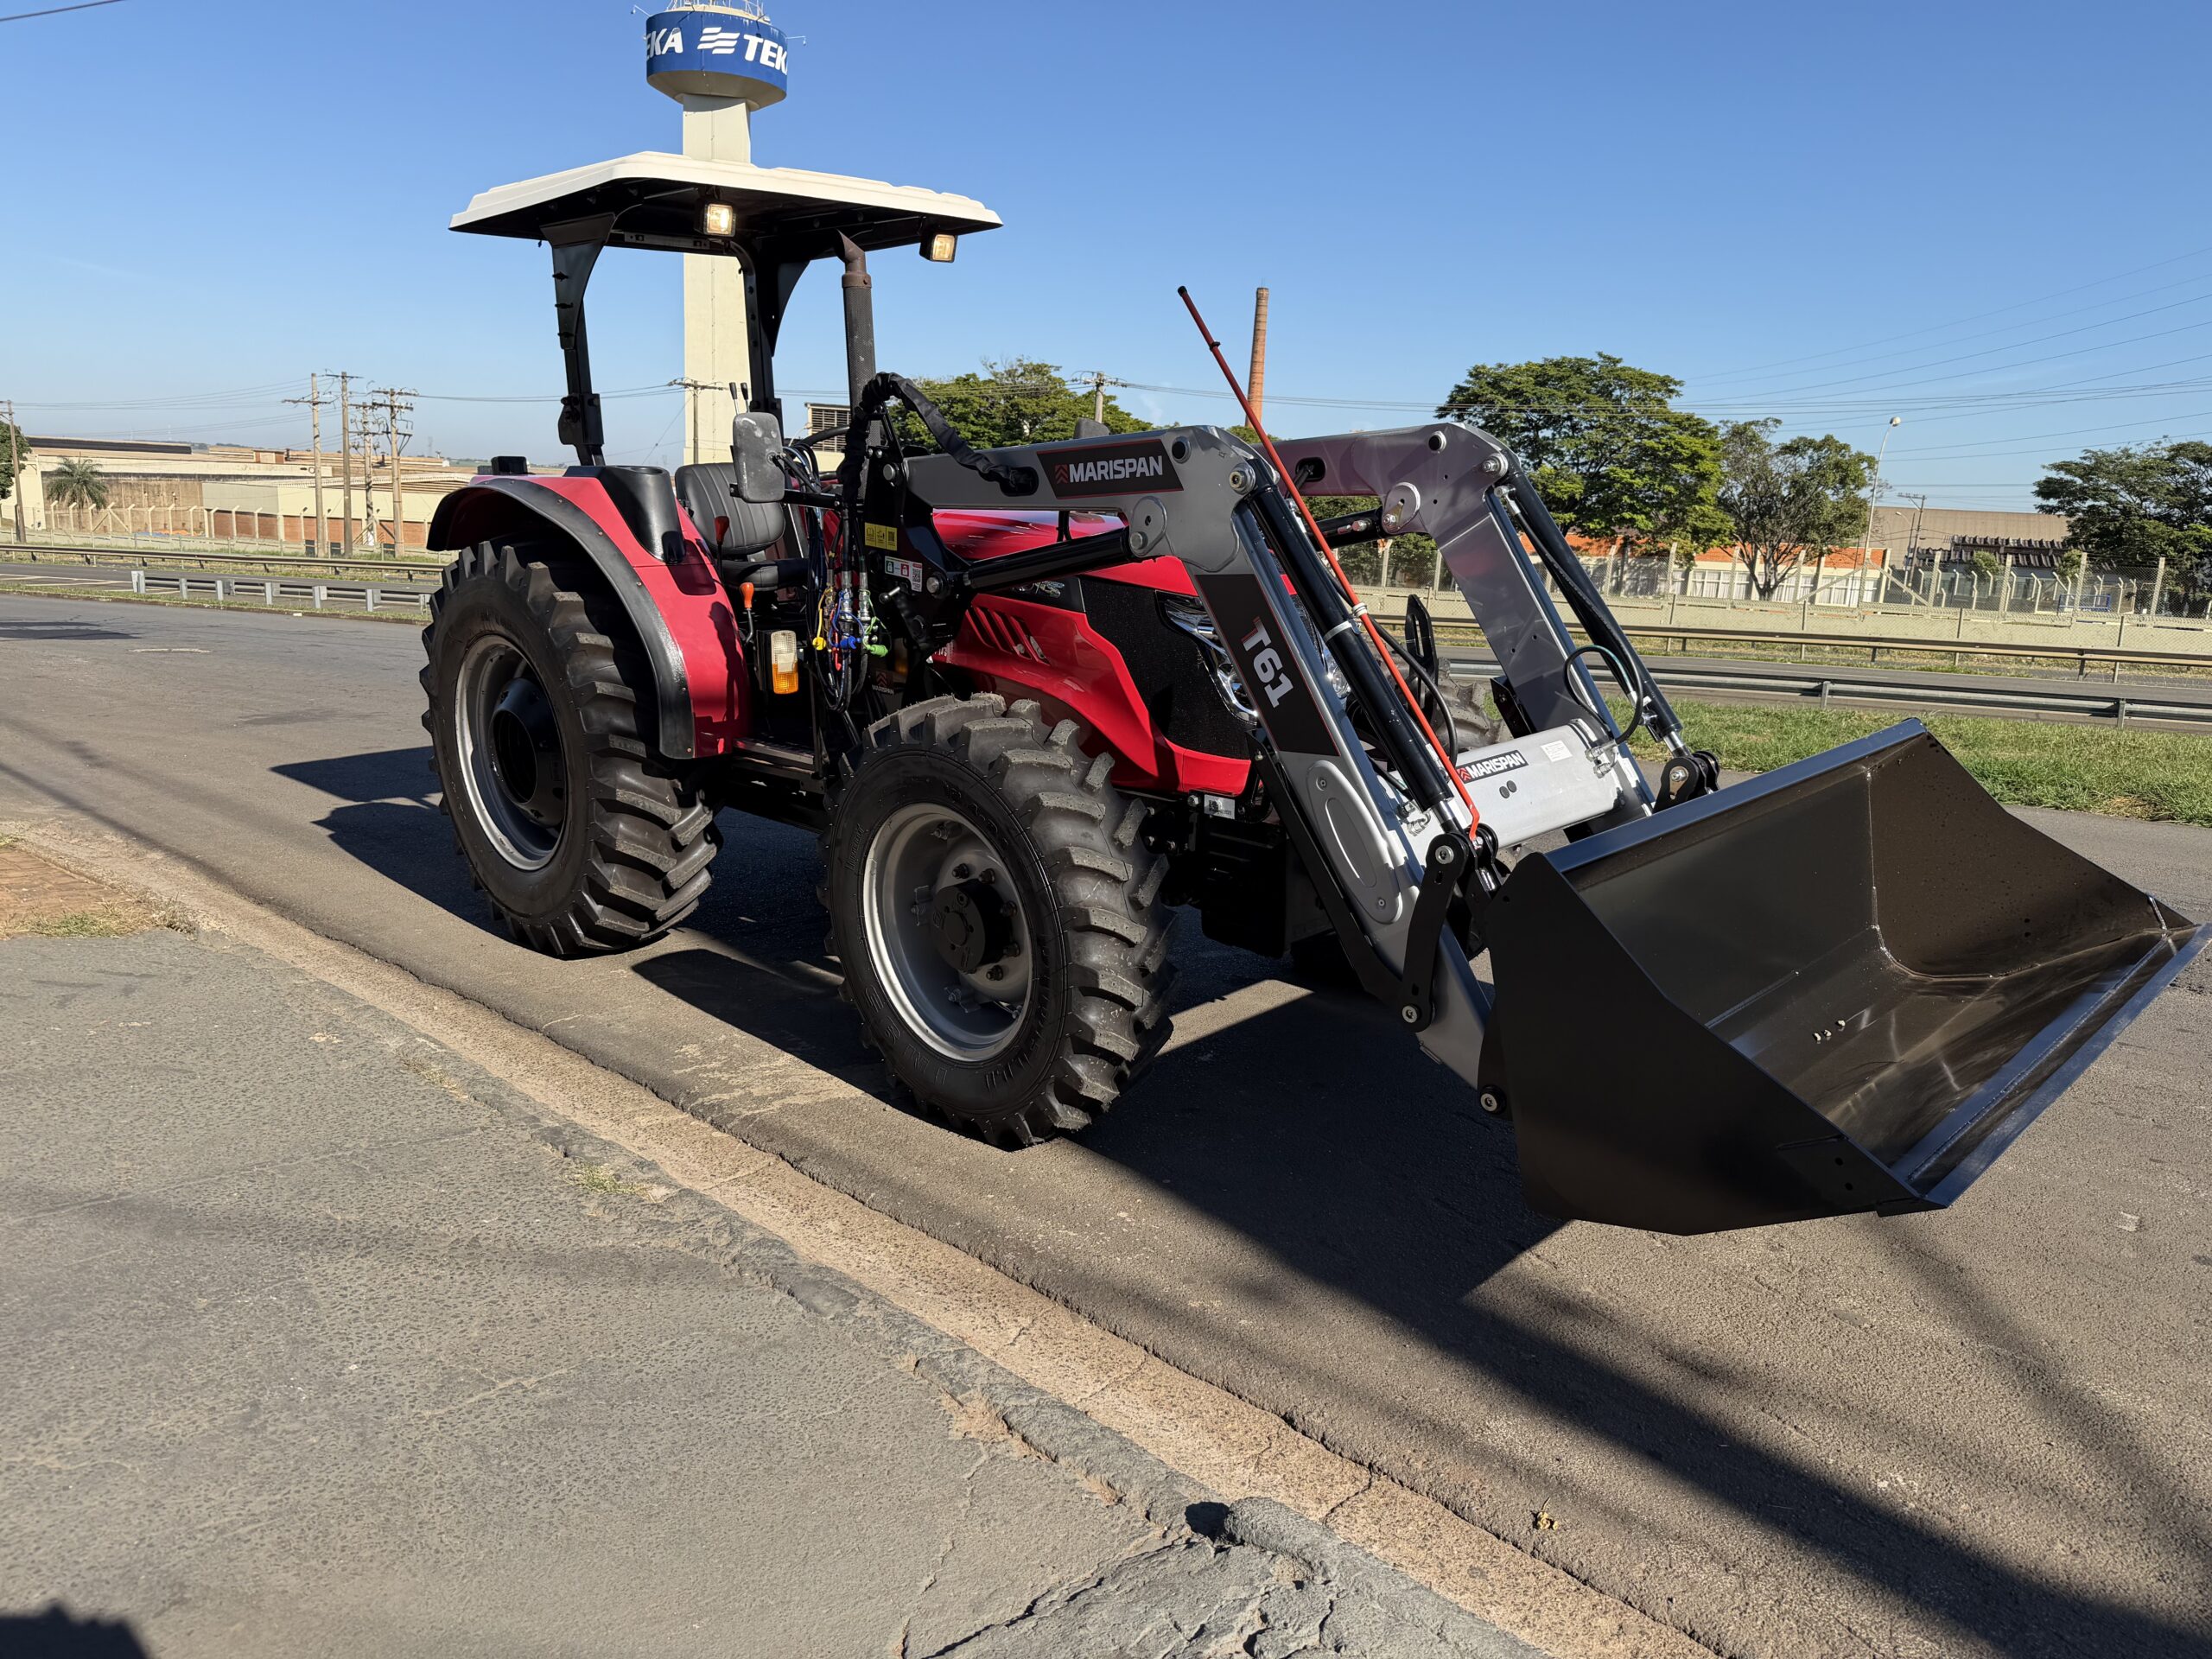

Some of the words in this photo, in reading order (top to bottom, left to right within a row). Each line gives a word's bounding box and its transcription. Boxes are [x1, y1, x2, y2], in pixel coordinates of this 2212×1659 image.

[743, 34, 787, 76] TEK
[1069, 454, 1163, 483] MARISPAN
[1241, 616, 1294, 709] T61
[1465, 752, 1526, 779] MARISPAN
